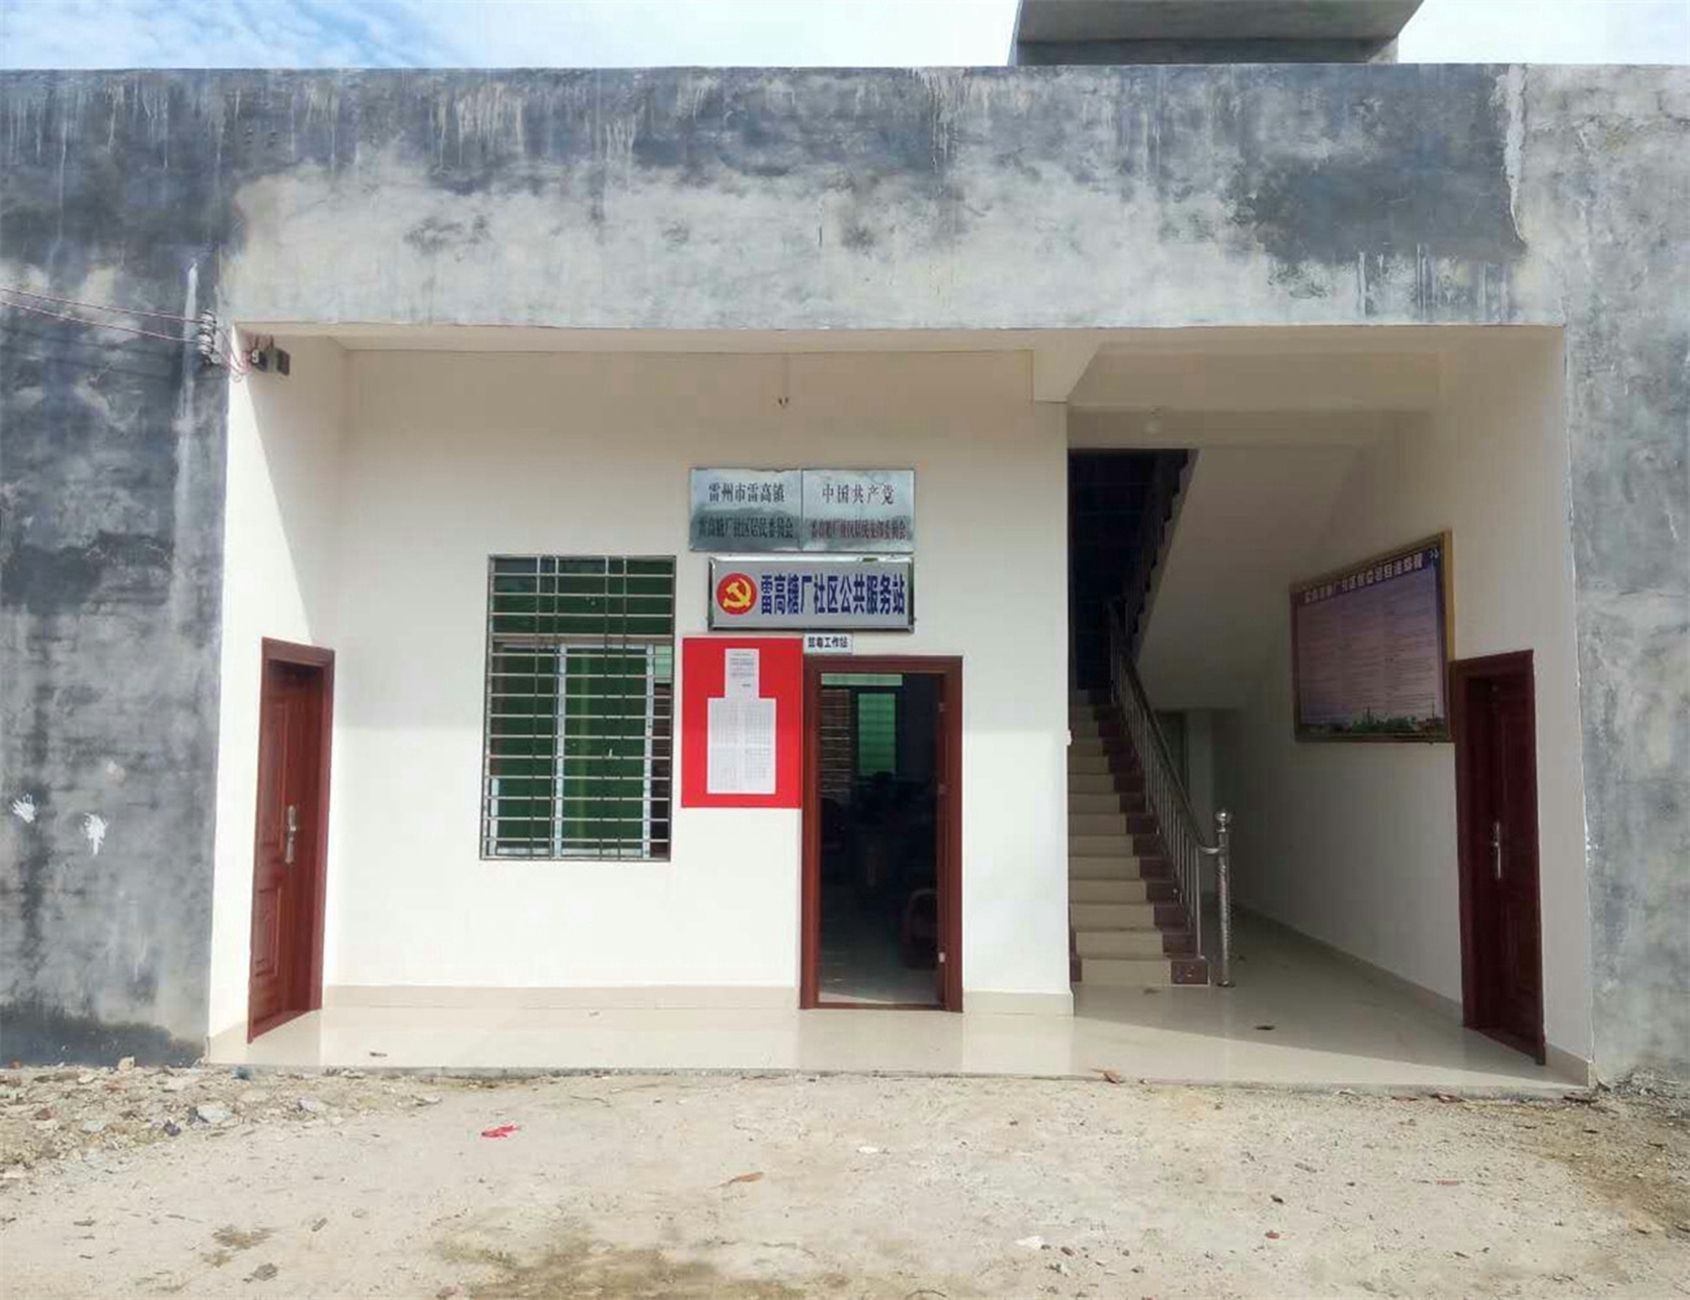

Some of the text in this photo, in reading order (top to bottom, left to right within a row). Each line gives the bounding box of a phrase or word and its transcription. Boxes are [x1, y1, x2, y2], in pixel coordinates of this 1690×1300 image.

[708, 482, 785, 503] 雷州市雷高镇
[821, 483, 895, 505] 中国共产党
[760, 574, 906, 615] 雷高糖厂社区公共服务站
